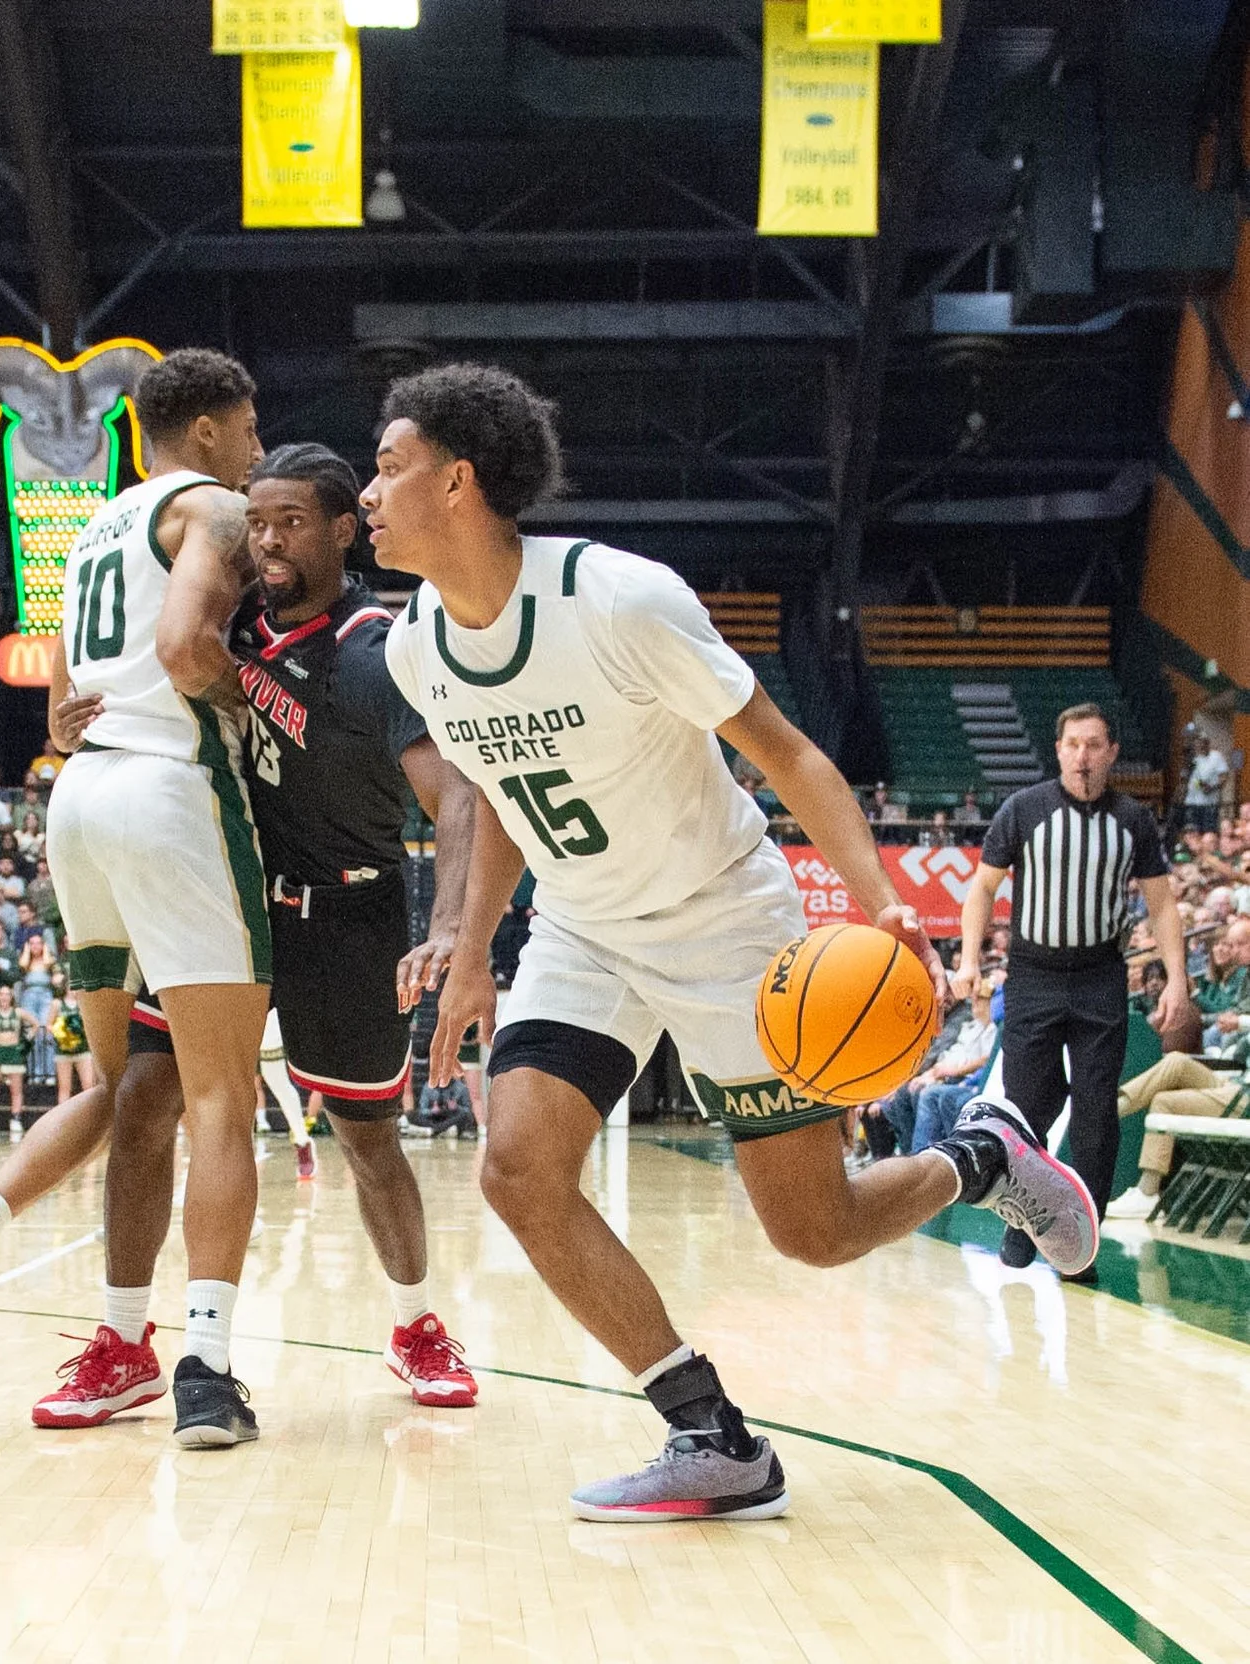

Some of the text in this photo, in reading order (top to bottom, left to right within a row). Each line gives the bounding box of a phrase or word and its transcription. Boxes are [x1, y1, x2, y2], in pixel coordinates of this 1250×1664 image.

[72, 548, 126, 667] 10
[236, 658, 307, 750] NVER
[445, 703, 586, 743] COLORADO
[477, 736, 561, 765] STATE
[498, 768, 610, 860] 15
